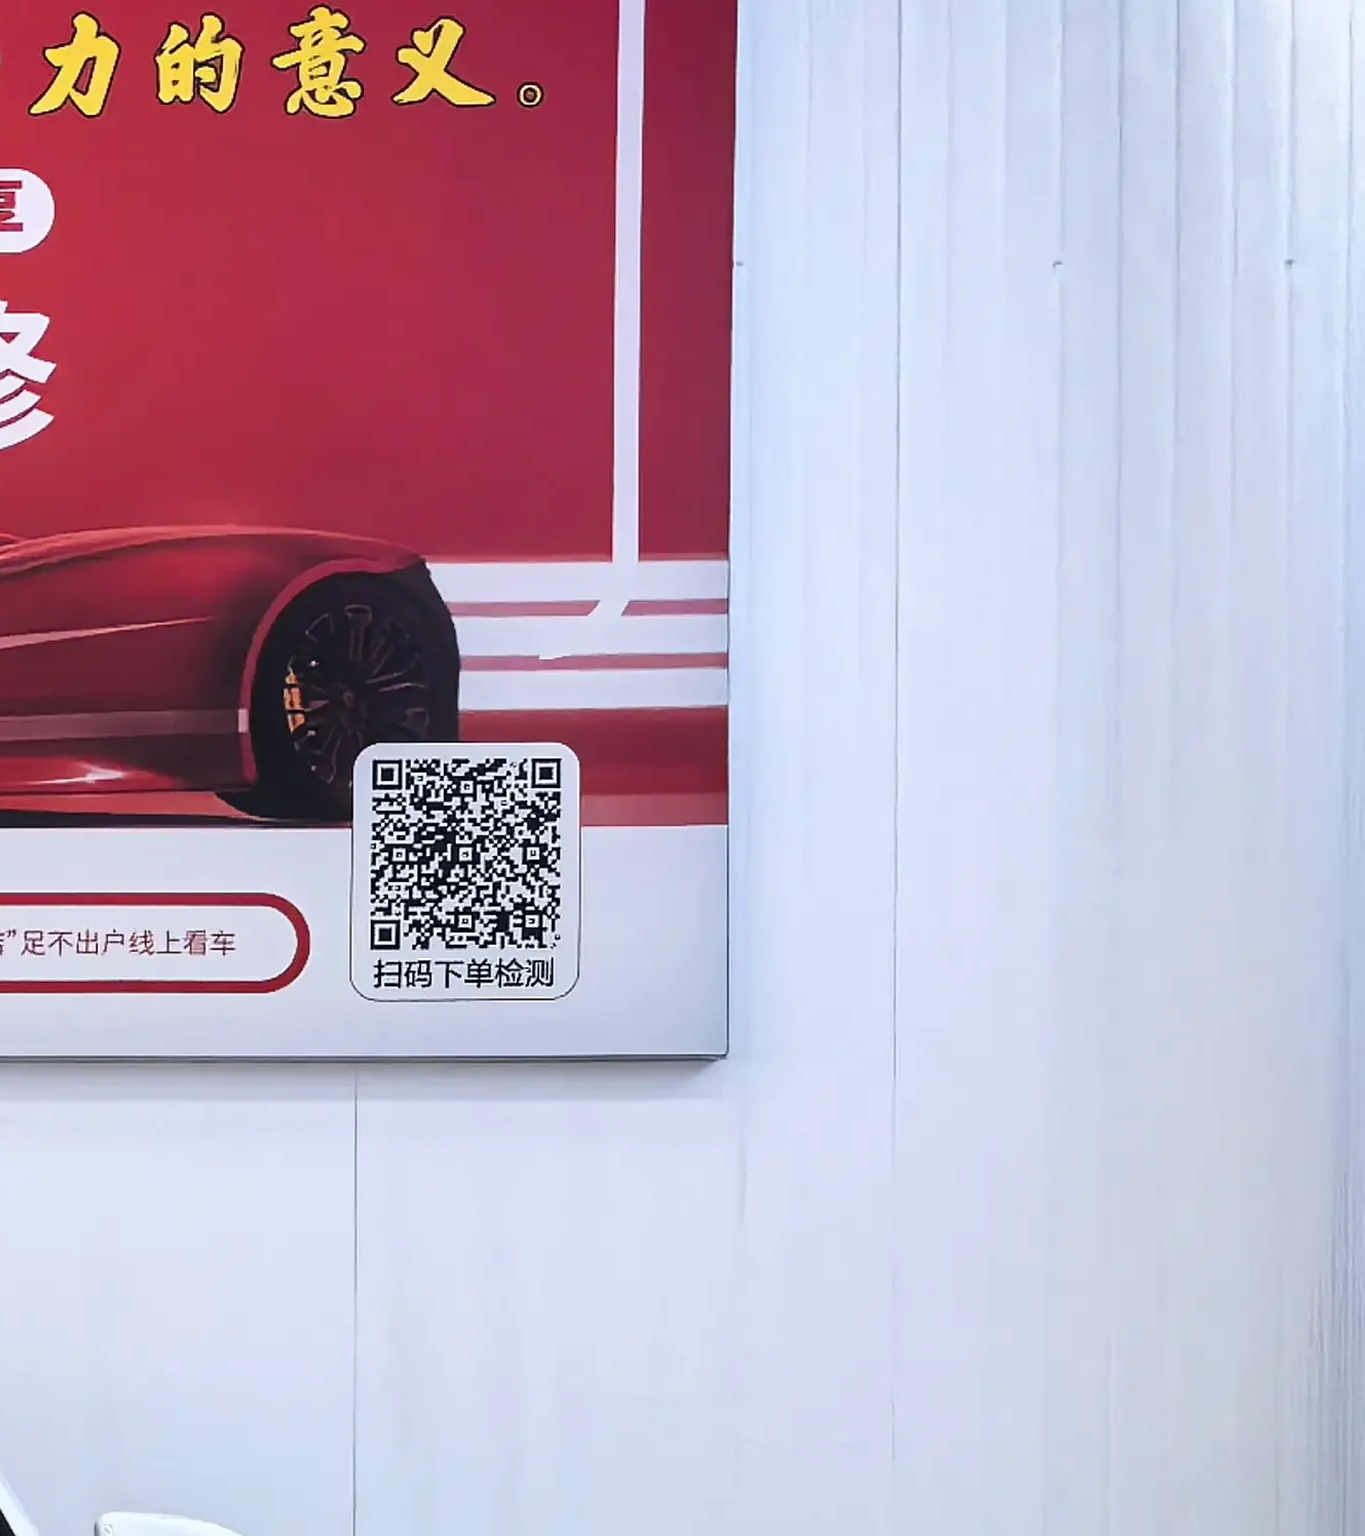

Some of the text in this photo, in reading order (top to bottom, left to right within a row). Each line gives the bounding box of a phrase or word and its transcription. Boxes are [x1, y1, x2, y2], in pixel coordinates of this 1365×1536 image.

[373, 957, 555, 989] 扫码下单检测
